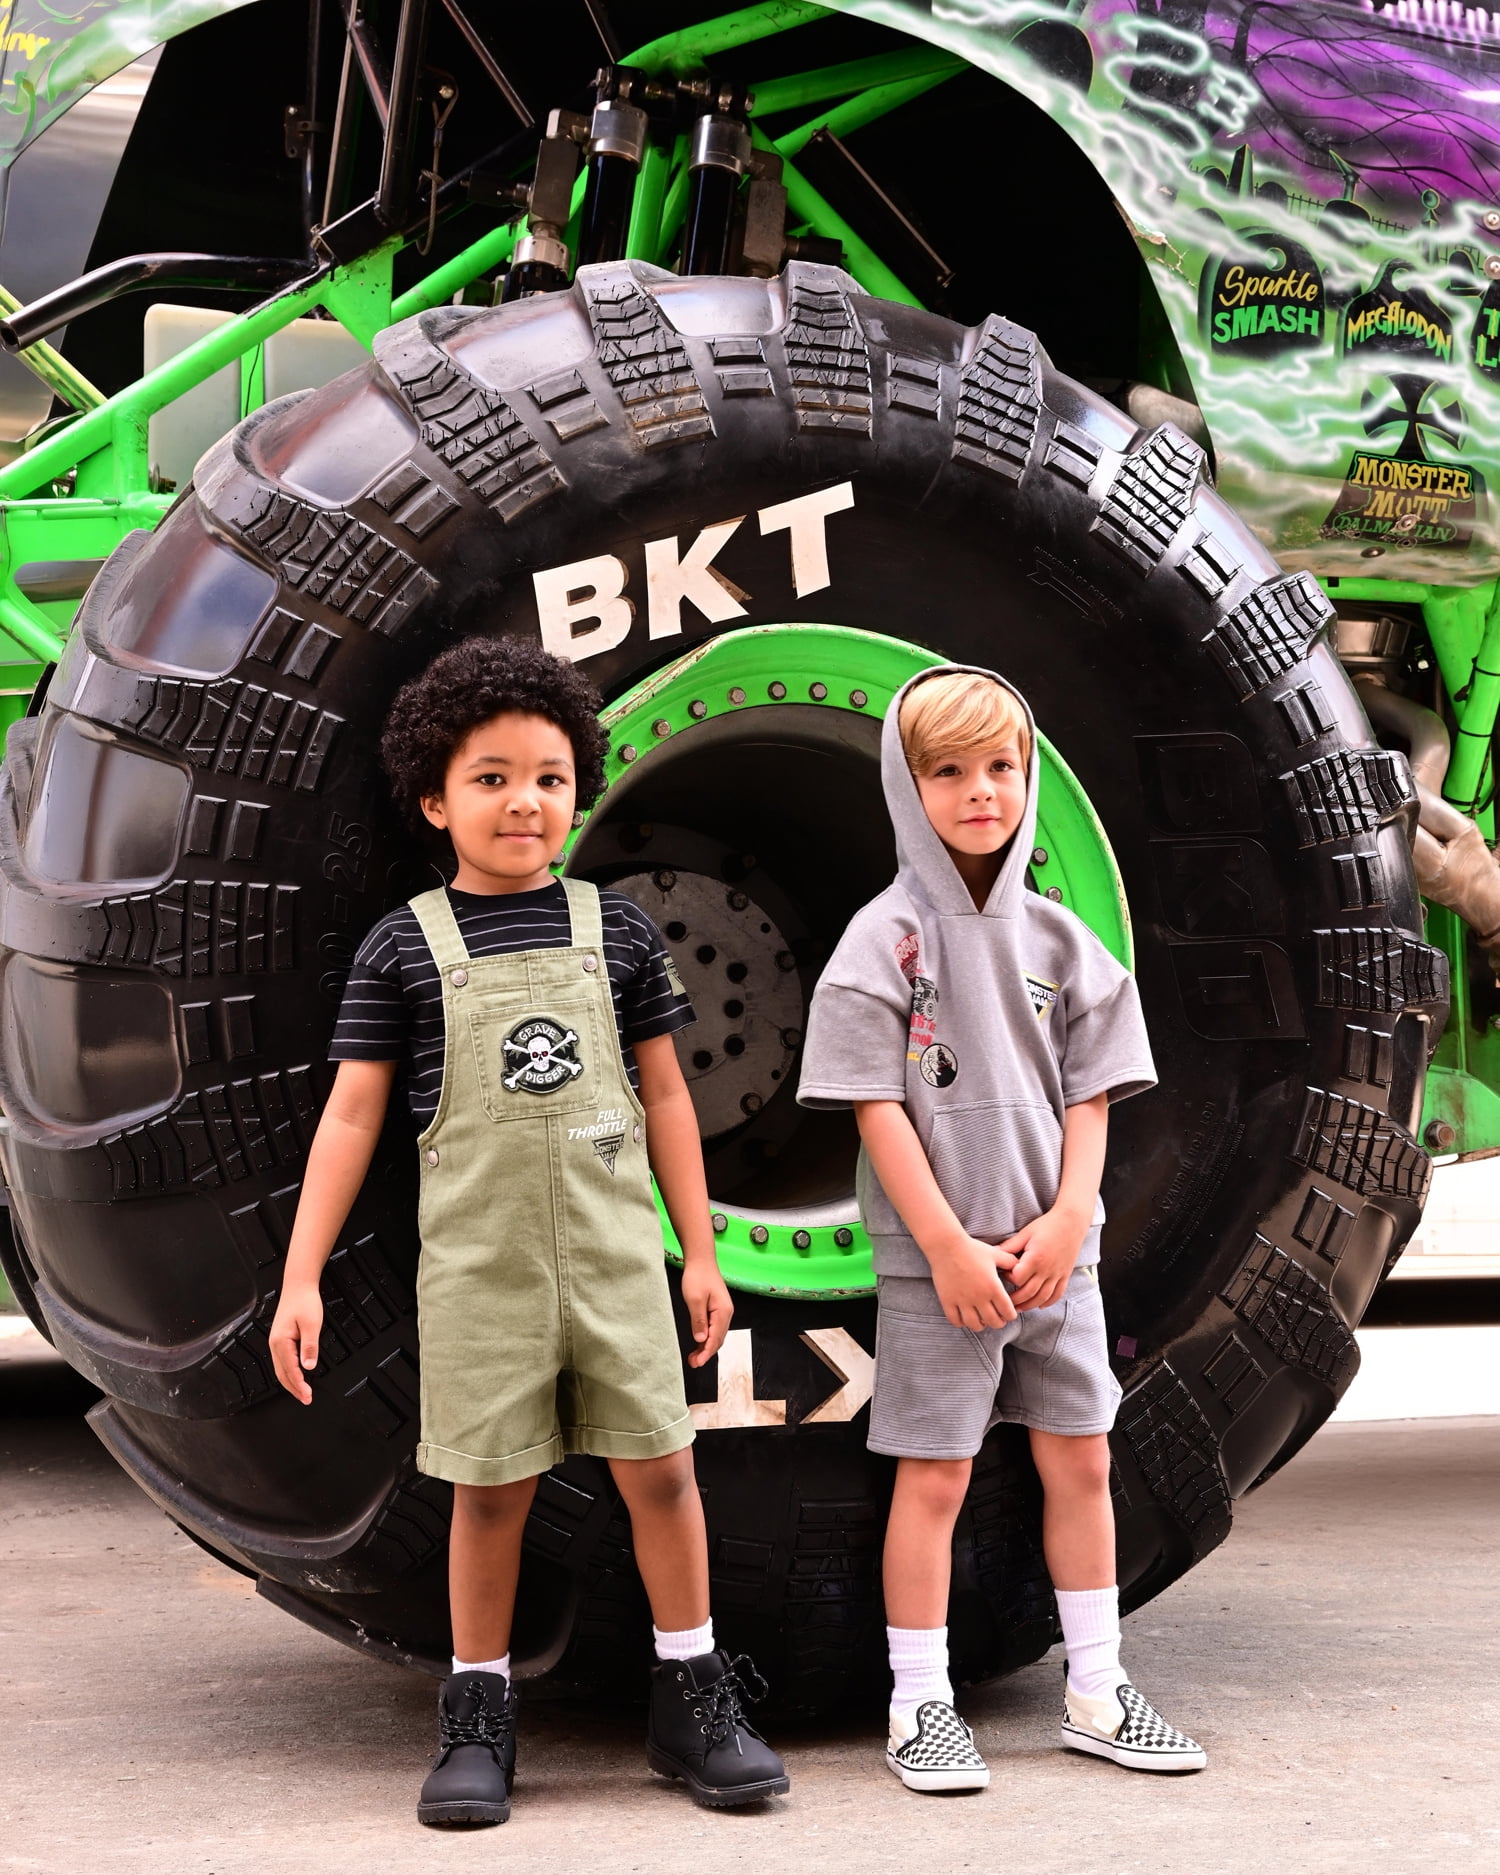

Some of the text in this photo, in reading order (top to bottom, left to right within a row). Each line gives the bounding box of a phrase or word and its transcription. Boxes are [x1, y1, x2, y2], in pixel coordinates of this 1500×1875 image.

[1218, 266, 1318, 307] Sparkle
[1212, 304, 1320, 344] SMASH
[1346, 301, 1452, 364] MEGALODON
[1351, 456, 1472, 499] MONSTER
[533, 481, 856, 664] BKT
[519, 1024, 557, 1041] GRAVE
[525, 1065, 566, 1084] DIGGER
[567, 1118, 628, 1140] THROTTLE
[596, 1107, 623, 1123] FULL
